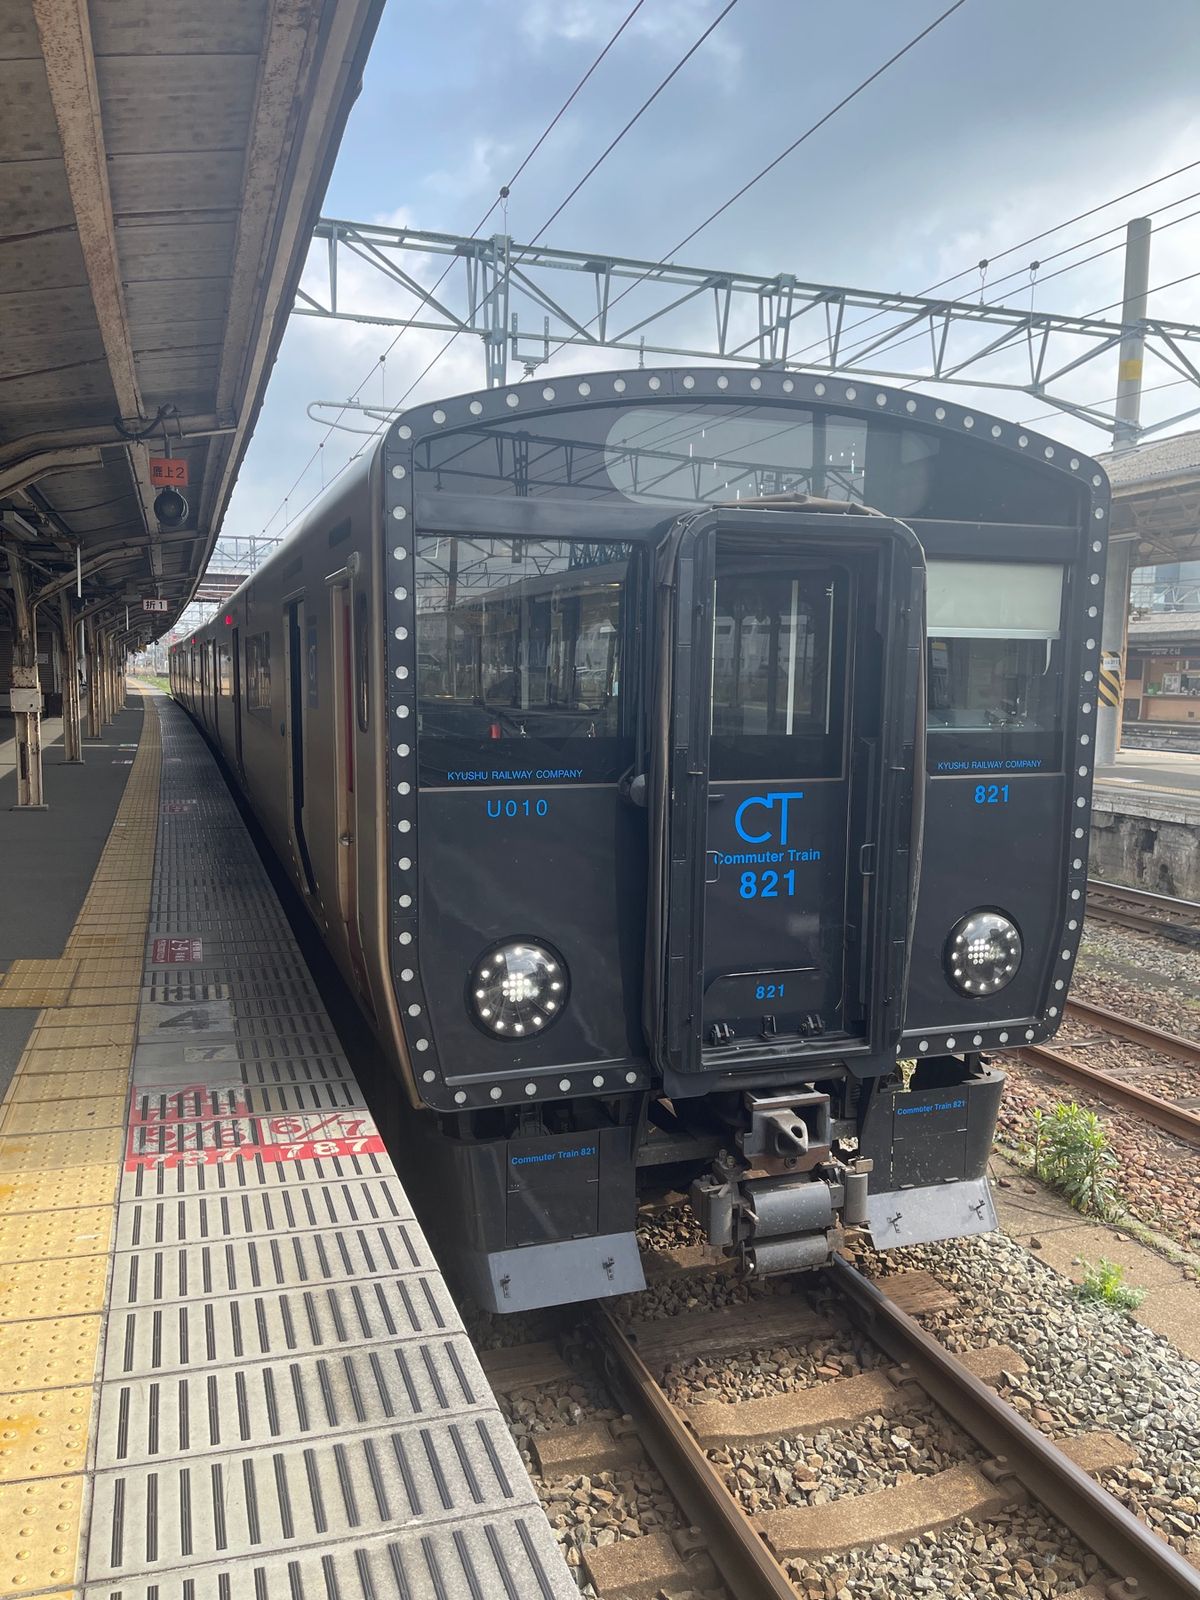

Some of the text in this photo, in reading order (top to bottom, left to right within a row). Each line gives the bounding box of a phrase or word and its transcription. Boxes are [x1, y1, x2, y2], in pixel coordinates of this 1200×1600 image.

[937, 759, 1042, 771] KYUSHU RAILWAY COMPANY
[447, 769, 583, 781] KYUSHU RAILWAY COMPANY
[974, 784, 1010, 804] 821
[487, 799, 548, 817] U010
[734, 792, 803, 845] CT
[713, 848, 821, 865] Commuter Train
[739, 869, 796, 899] 821
[756, 984, 785, 999] 821
[897, 1100, 966, 1115] Commuter Train 821
[270, 1114, 366, 1141] 6/7
[280, 1138, 368, 1159] 787
[511, 1147, 596, 1166] Commuter Train 821
